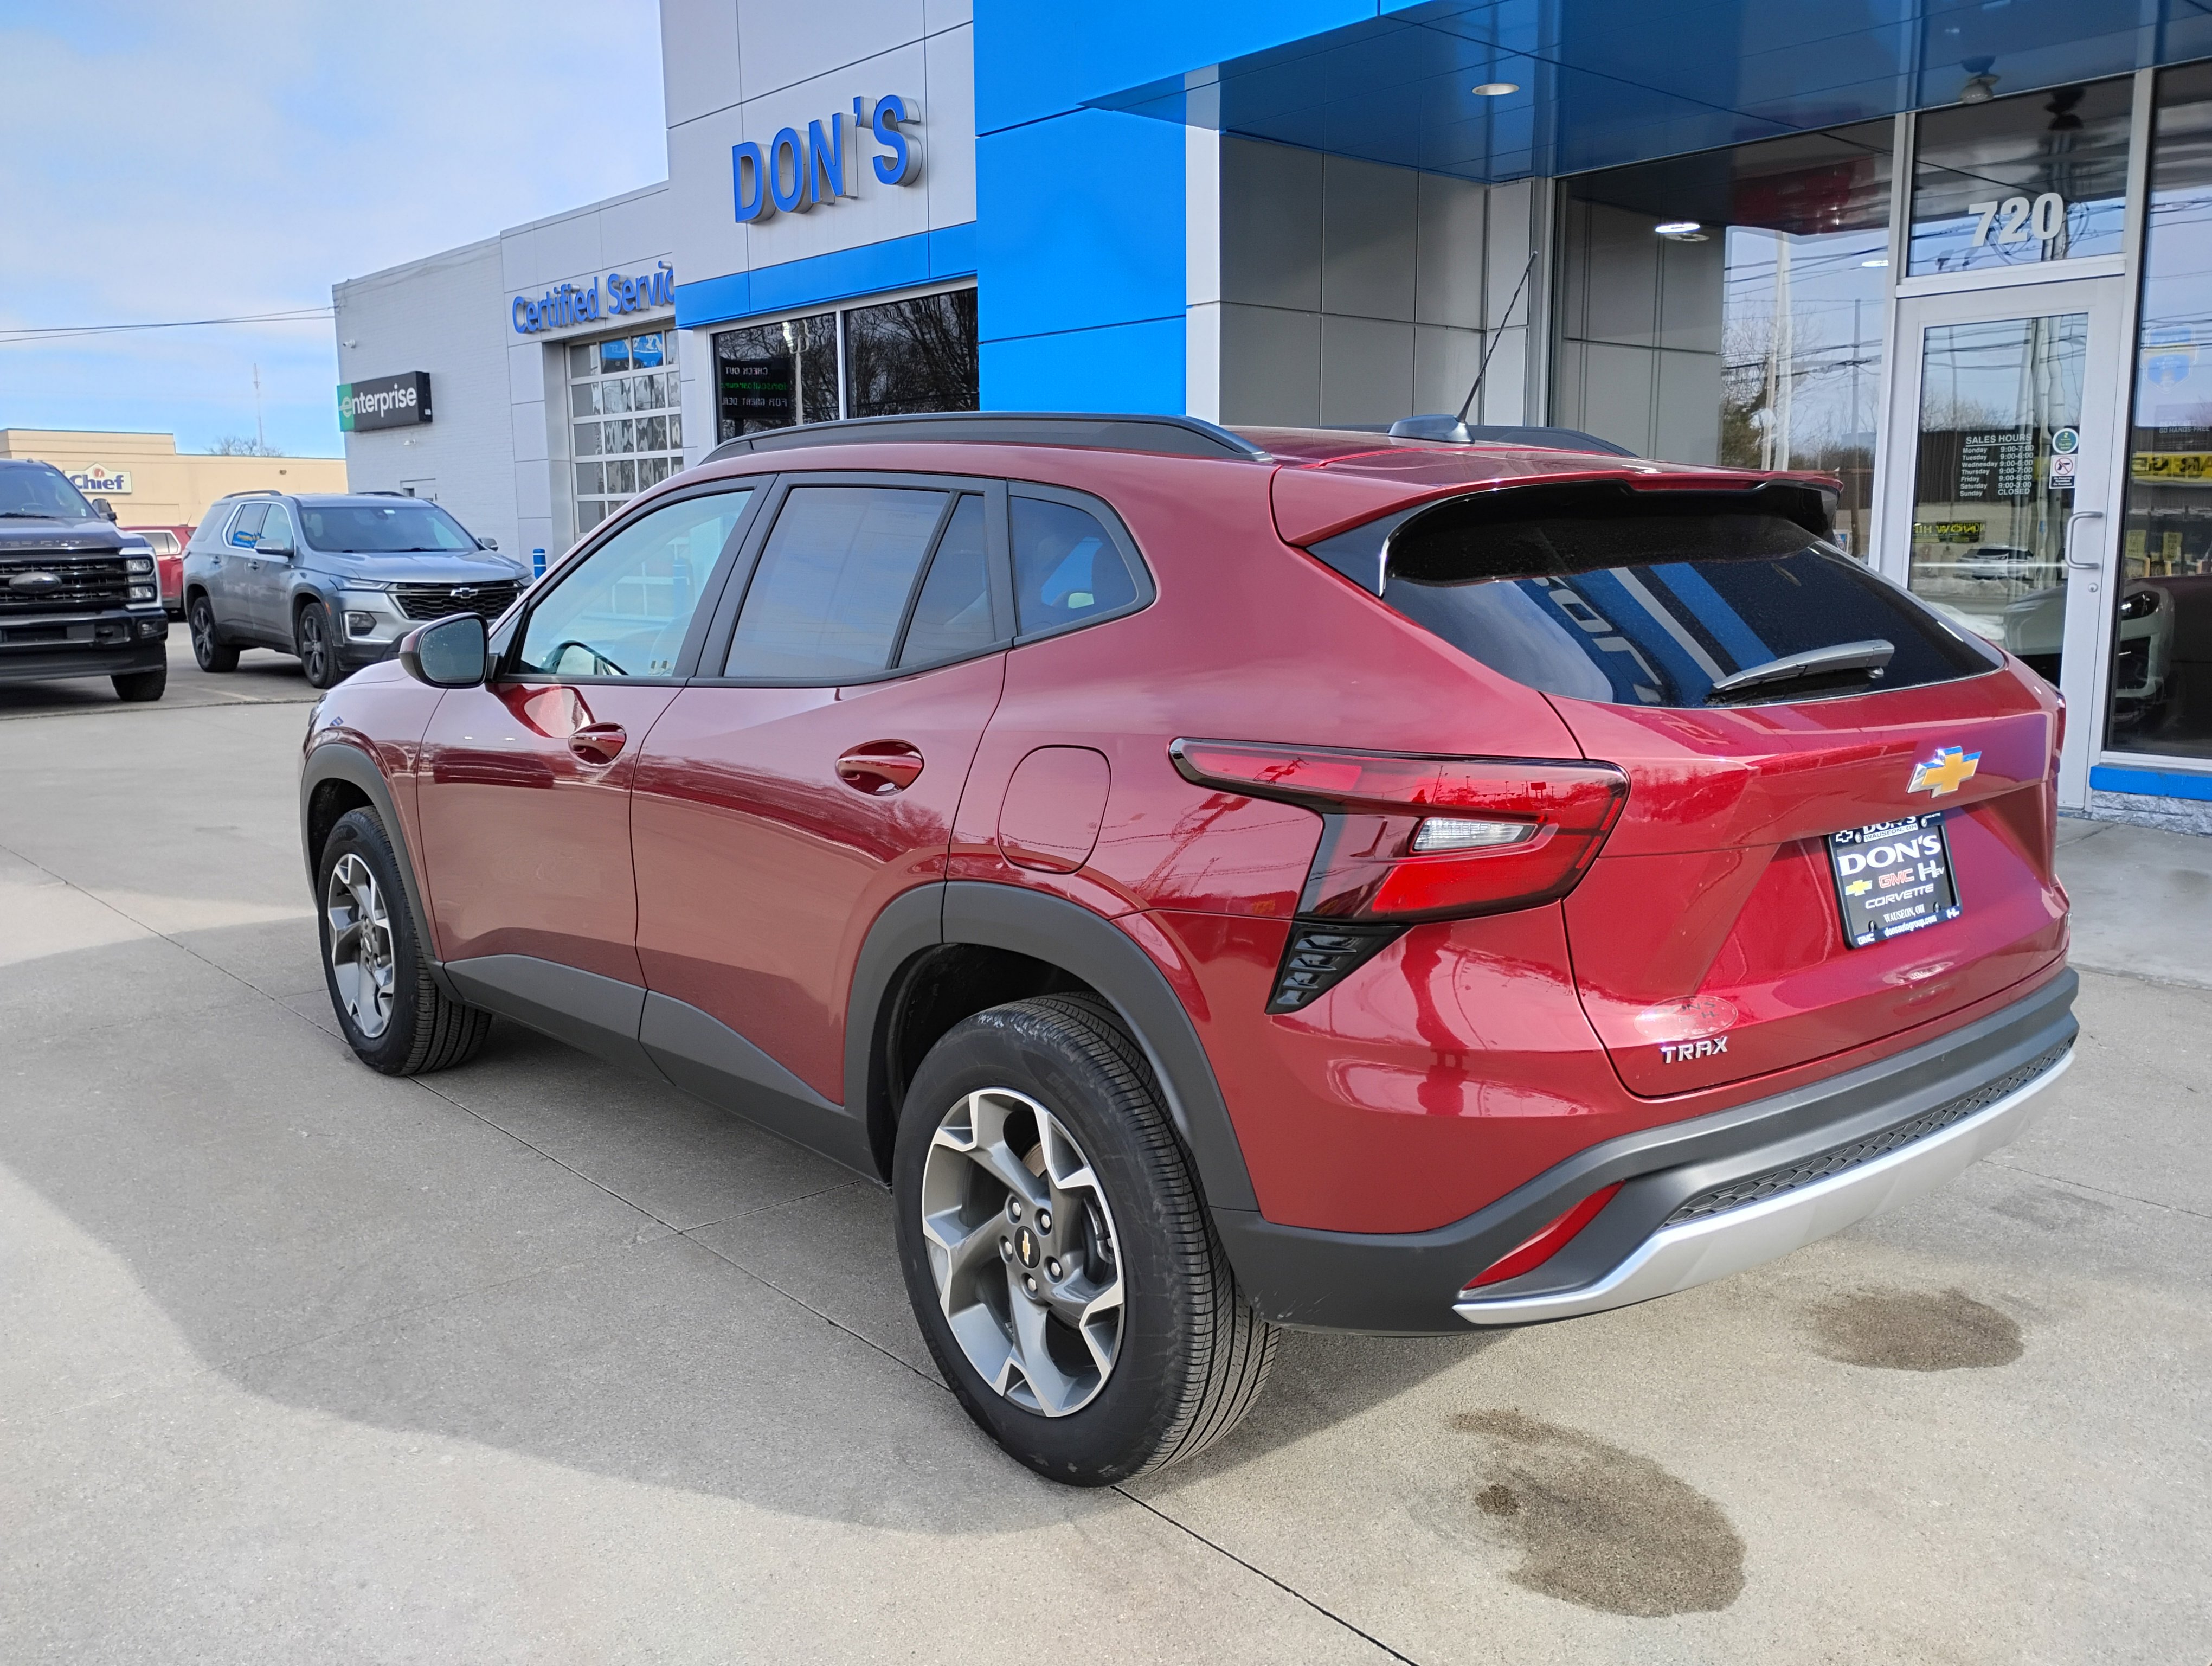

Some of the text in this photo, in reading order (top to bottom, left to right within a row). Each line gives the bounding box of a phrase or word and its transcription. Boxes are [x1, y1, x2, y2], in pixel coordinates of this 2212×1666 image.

[732, 94, 913, 223] DON'S
[1969, 193, 2063, 247] 720
[512, 260, 674, 334] Certified Servic
[339, 383, 416, 418] enterprise
[1966, 434, 2032, 444] SALES HOURS
[70, 475, 124, 489] Chief
[1998, 488, 2030, 496] CLOSED
[1837, 835, 1941, 876] DON'S
[1878, 868, 1915, 889] GMC
[1865, 883, 1934, 909] CORVETTE
[1883, 904, 1925, 923] WAUSEON, OH
[1884, 915, 1937, 937] donsautogroup.com
[1857, 933, 1875, 946] GMC
[1660, 1036, 1728, 1064] TRAX
